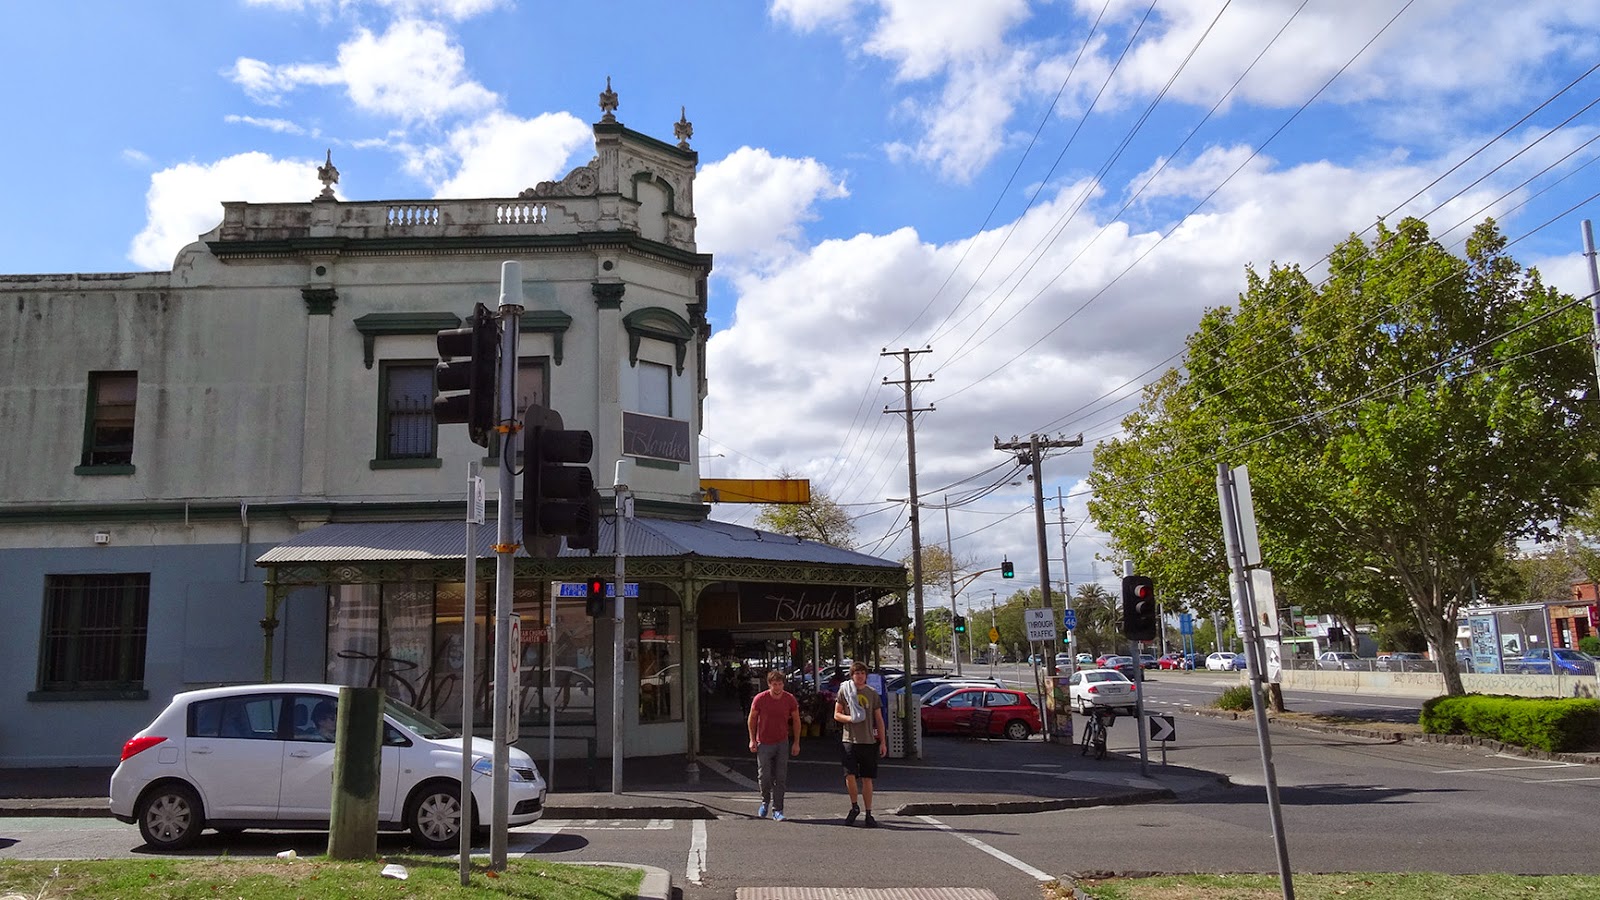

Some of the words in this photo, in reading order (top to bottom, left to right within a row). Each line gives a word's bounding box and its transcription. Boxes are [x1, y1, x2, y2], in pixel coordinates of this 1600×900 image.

[624, 424, 687, 460] Blondies
[764, 591, 851, 622] Blondies
[1034, 611, 1044, 619] NO
[1027, 620, 1054, 629] THROUGH
[1065, 618, 1076, 626] 46
[1030, 629, 1054, 638] TRAFFIC
